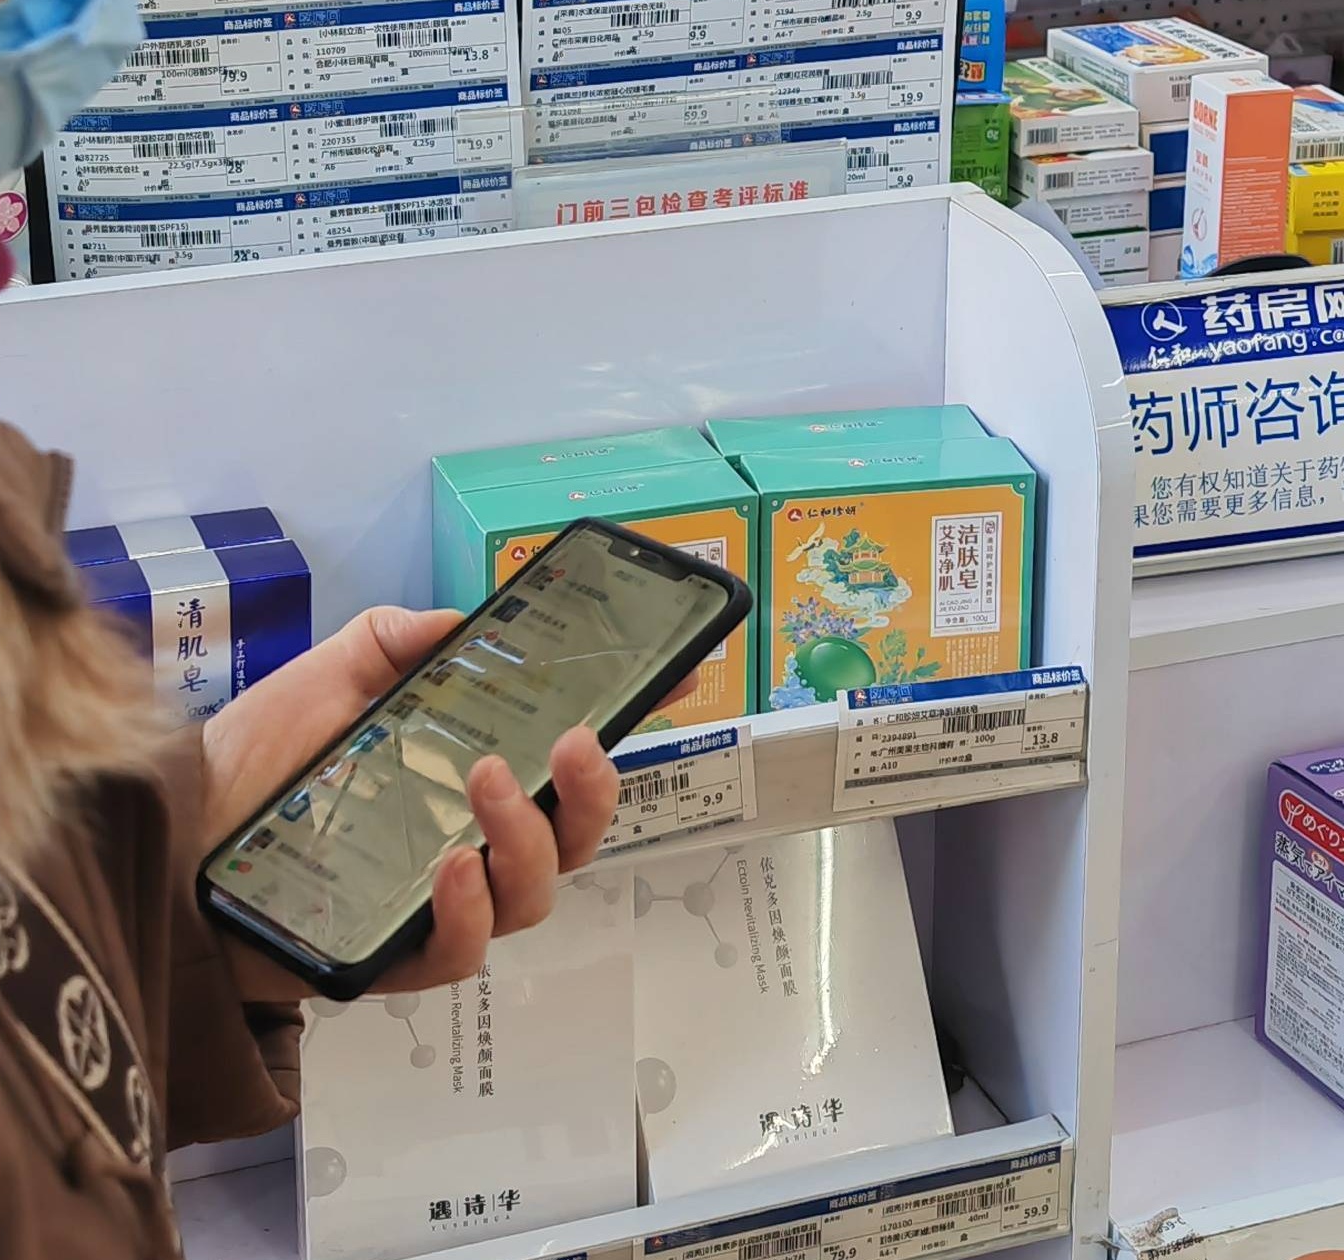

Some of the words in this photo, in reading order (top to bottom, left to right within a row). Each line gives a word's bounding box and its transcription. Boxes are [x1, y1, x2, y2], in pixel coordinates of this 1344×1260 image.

[856, 10, 872, 19] 2.5g
[905, 10, 922, 21] 9.9
[223, 17, 273, 31] 商品标价签
[315, 46, 347, 56] 110709
[896, 39, 939, 51] 商品标价签
[692, 58, 737, 72] 商品标价签
[900, 91, 924, 103] 19.9
[893, 120, 936, 133] 商品标价签
[320, 136, 357, 147] 2207355
[412, 139, 436, 149] 4.25g
[468, 137, 494, 151] 19.9
[461, 176, 509, 190] 商品标价签
[846, 172, 867, 182] 20ml
[235, 198, 284, 212] 商品标价签
[555, 179, 811, 228] 门前三包检查考评标准
[326, 225, 352, 236] 48254
[417, 227, 436, 238] 3.5g
[174, 250, 194, 260] 3.5g
[938, 524, 955, 592] 艾草净肌
[957, 523, 980, 590] 洁肤皂
[176, 597, 209, 693] 清肌皂
[1031, 668, 1081, 685] 商品标价签
[679, 732, 733, 754] 商品标价签
[974, 733, 996, 745] 100g
[1031, 732, 1059, 746] 13.8
[880, 760, 898, 771] A10
[702, 791, 724, 808] 9.9
[639, 802, 658, 815] 80g
[735, 858, 750, 896] Ectoin
[742, 896, 762, 966] Revitalizing
[760, 856, 799, 998] 依克多因焕颜面膜
[754, 962, 770, 994] Mask
[451, 997, 463, 1063] Revitalizing
[476, 964, 495, 1098] 依克多因焕颜面膜
[452, 1064, 463, 1094] Mask
[967, 1210, 990, 1224] 40ml
[1022, 1203, 1050, 1221] 59.9
